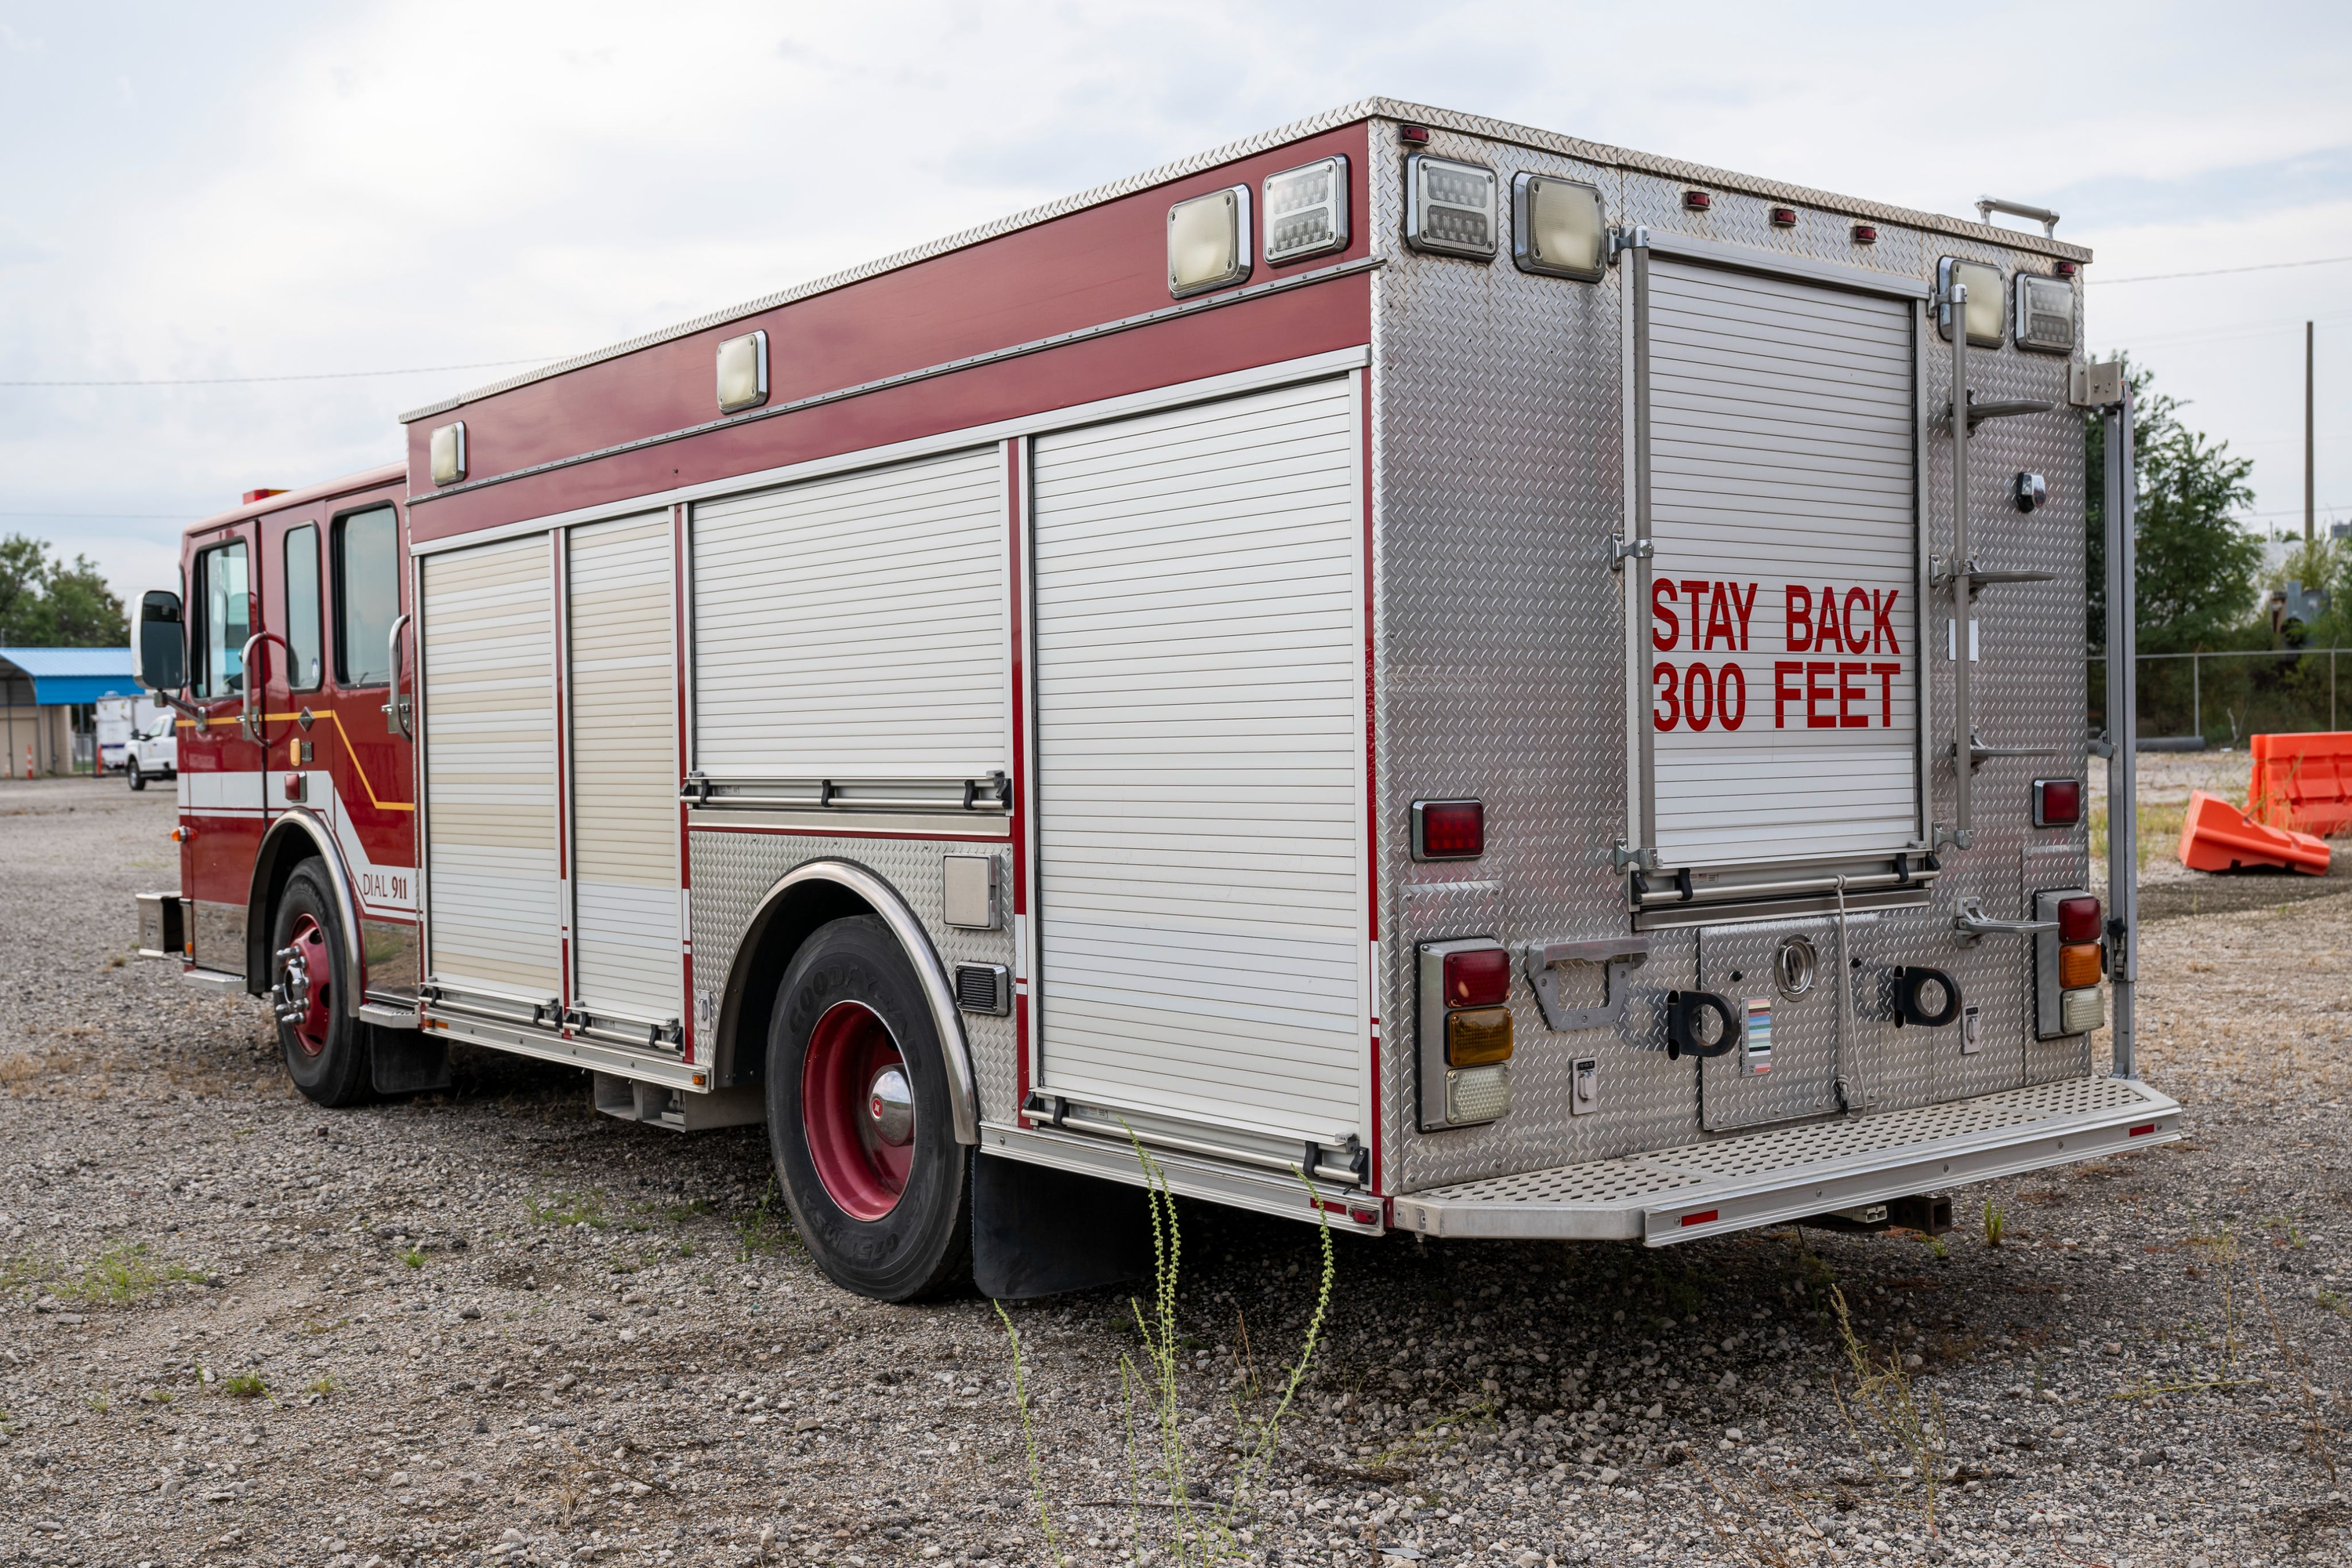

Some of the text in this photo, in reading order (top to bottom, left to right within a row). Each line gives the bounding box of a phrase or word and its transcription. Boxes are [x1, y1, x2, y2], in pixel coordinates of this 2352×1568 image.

[1652, 577, 1901, 655] STAY BACK
[1653, 661, 1901, 732] 300 FEET
[363, 873, 407, 900] DIAL 911
[789, 963, 922, 1073] GOODYAR
